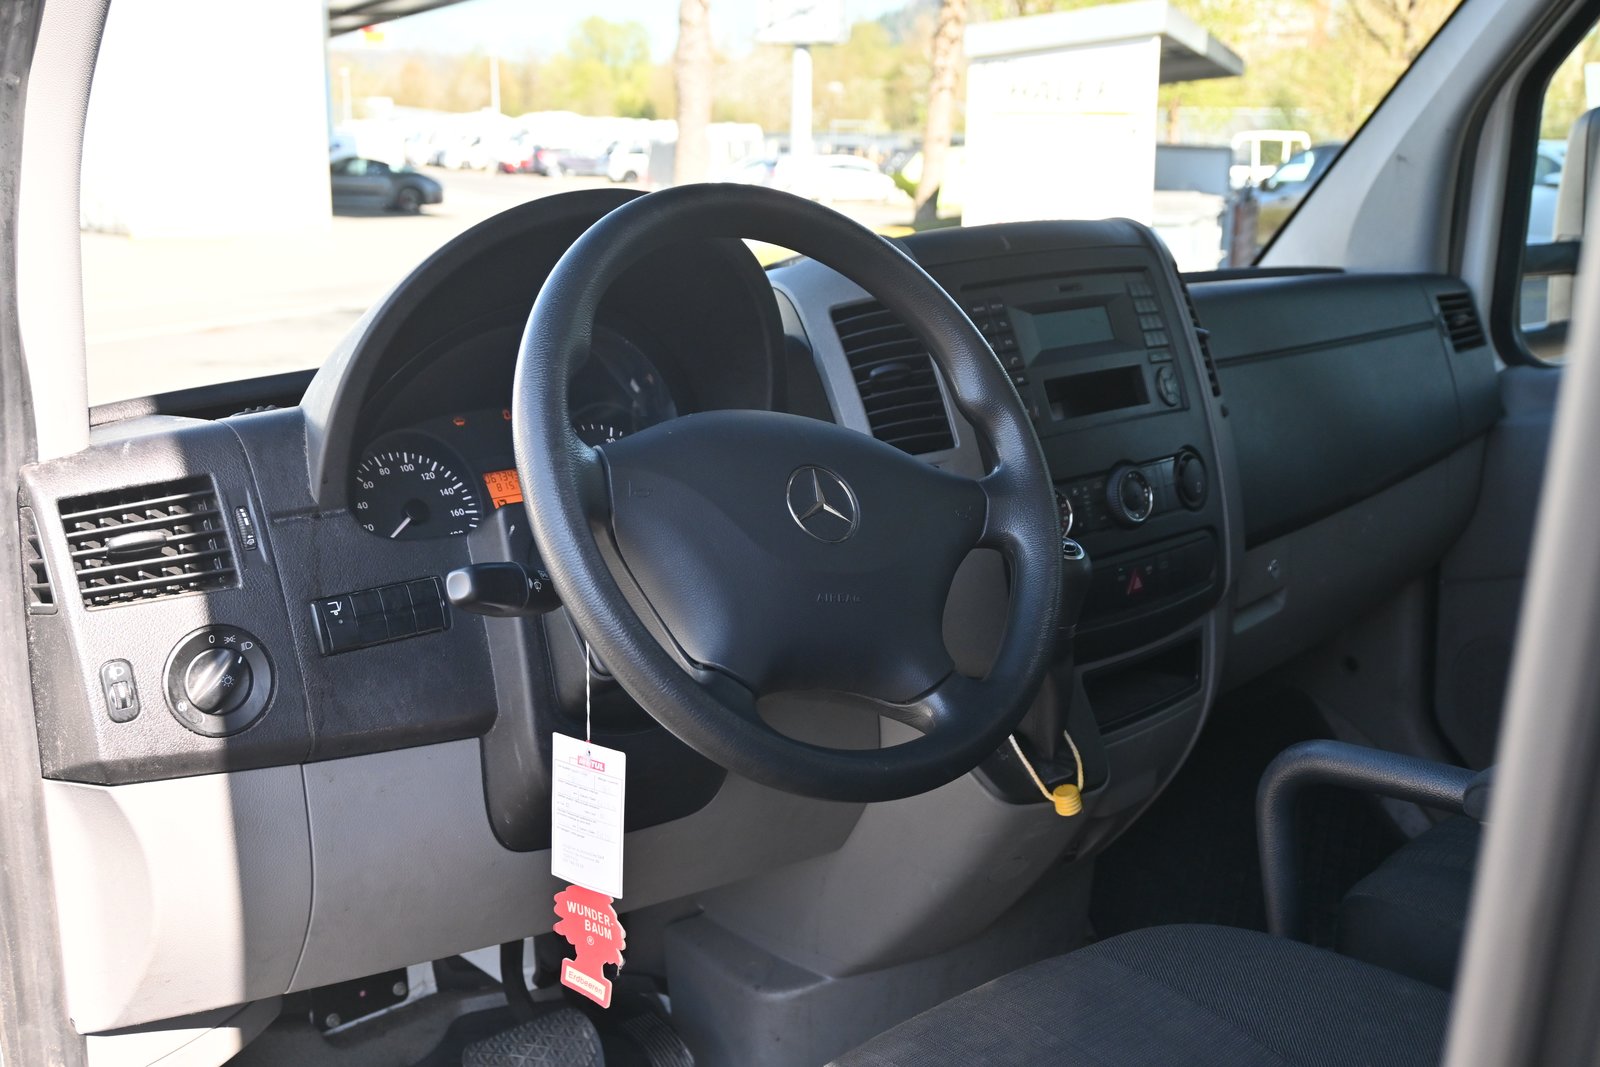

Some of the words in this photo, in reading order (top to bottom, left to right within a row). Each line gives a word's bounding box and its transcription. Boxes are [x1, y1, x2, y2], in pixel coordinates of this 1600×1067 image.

[379, 466, 390, 476] 80
[399, 463, 415, 473] 100
[421, 470, 436, 481] 120
[362, 480, 374, 490] 60
[440, 486, 454, 497] 140
[356, 501, 368, 511] 40
[450, 507, 465, 517] 160
[566, 900, 614, 926] WUNDER-
[584, 919, 613, 941] BAUM
[567, 970, 604, 996] Erdbeeren
